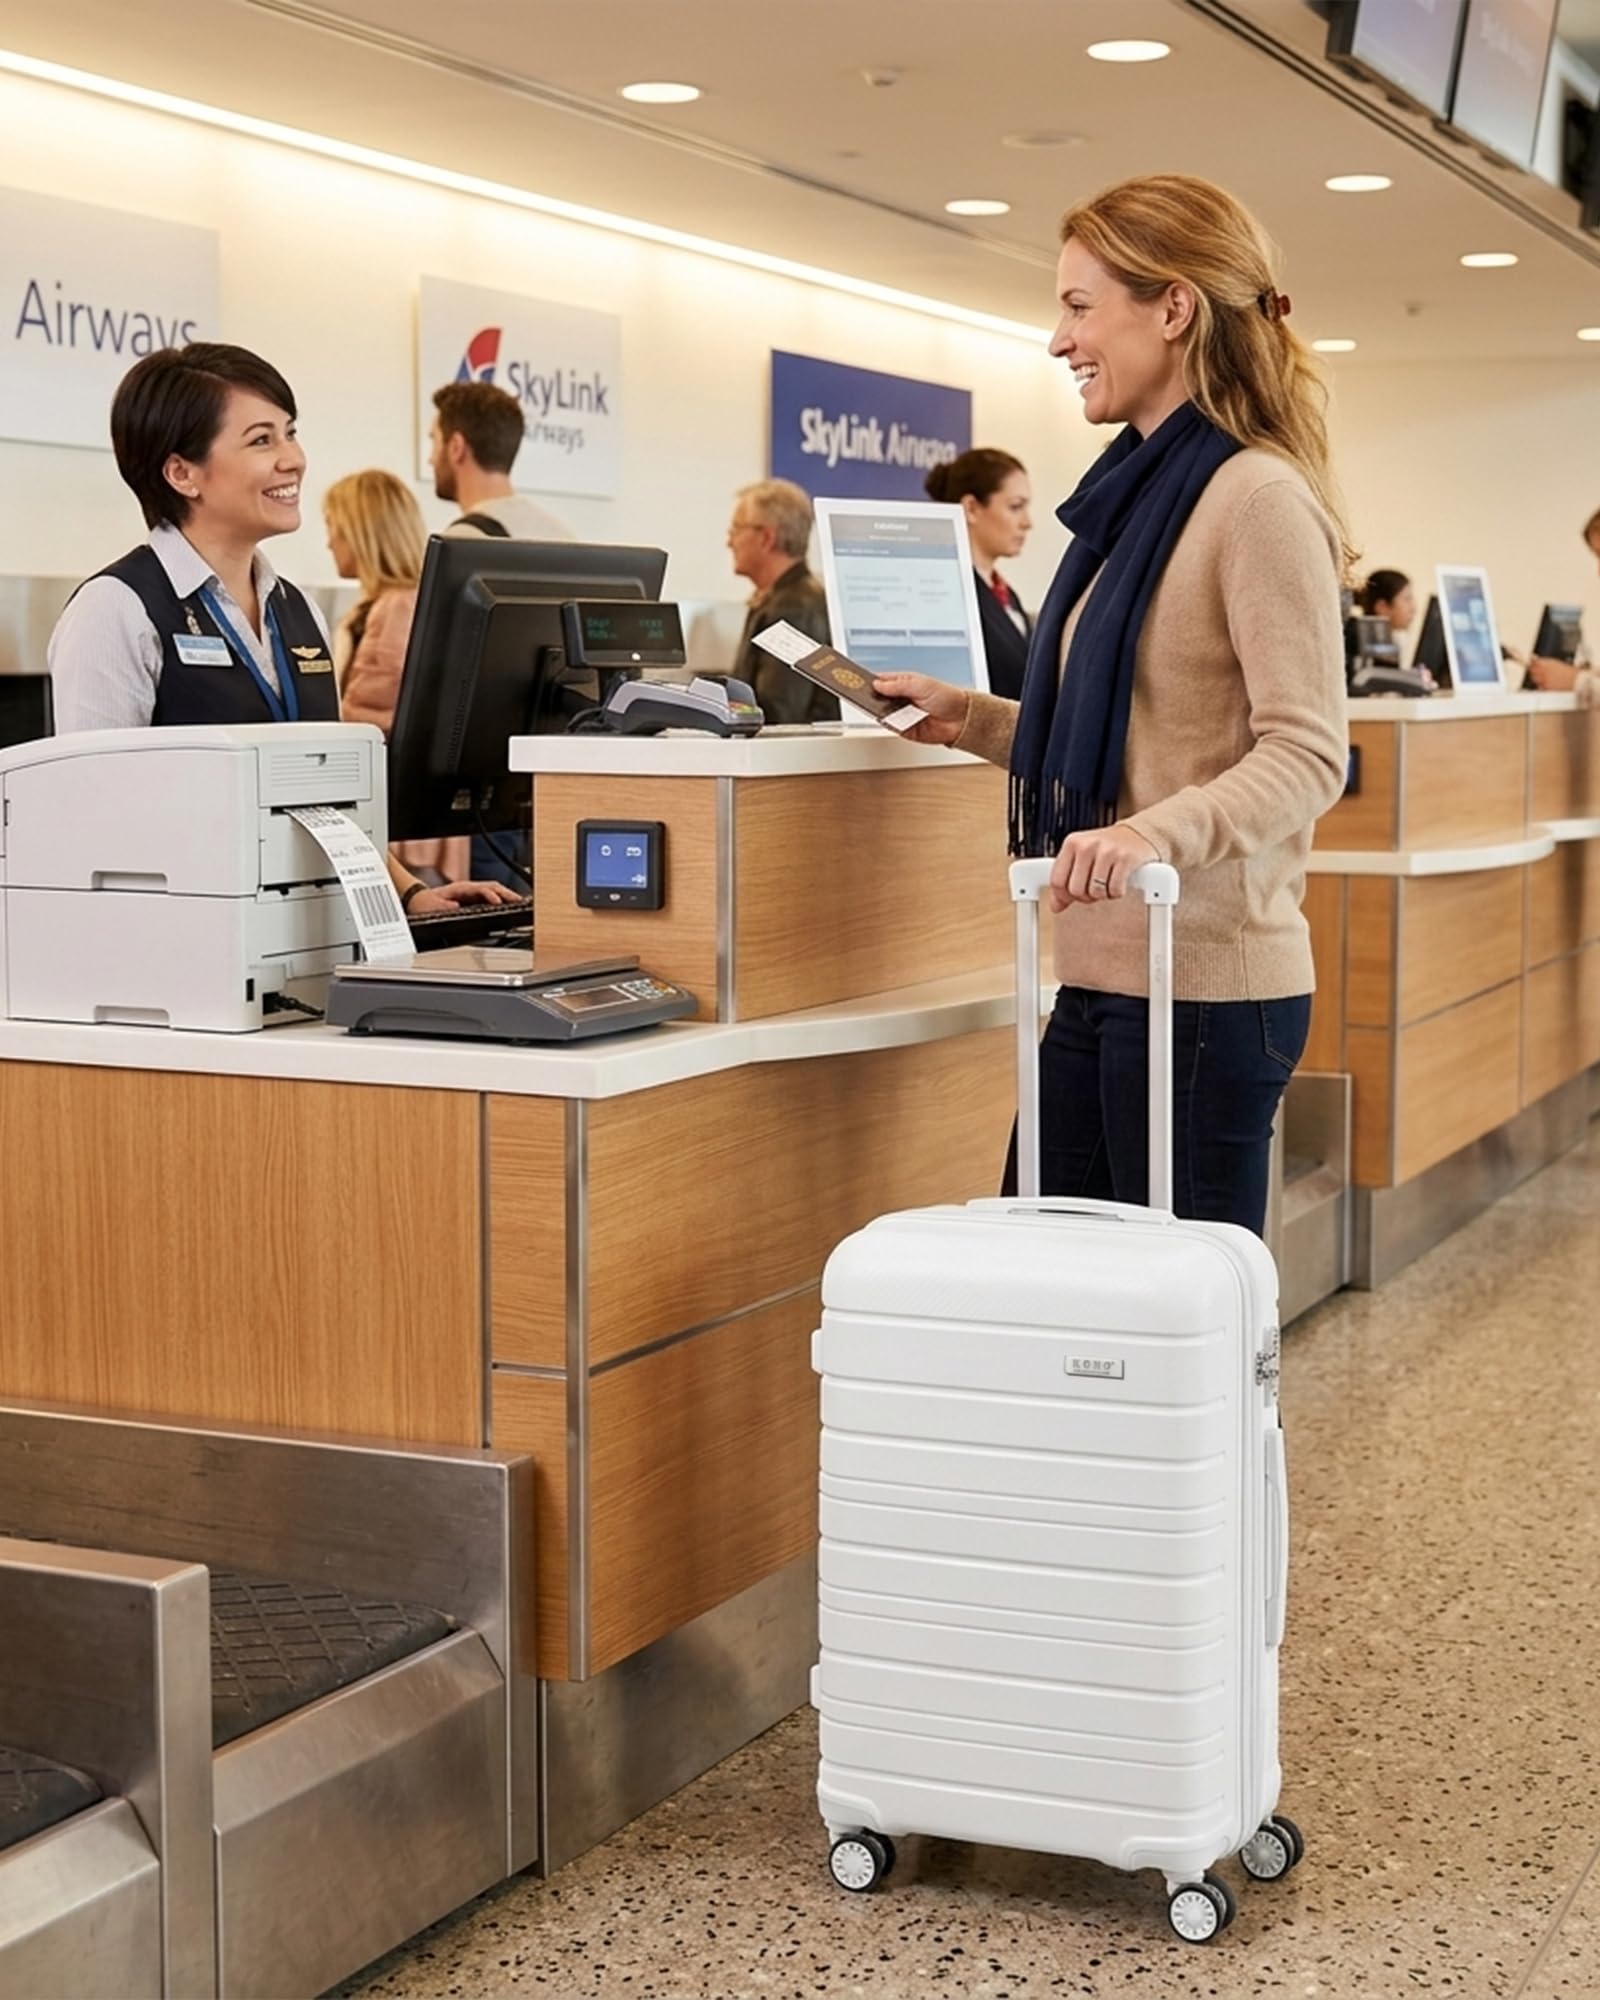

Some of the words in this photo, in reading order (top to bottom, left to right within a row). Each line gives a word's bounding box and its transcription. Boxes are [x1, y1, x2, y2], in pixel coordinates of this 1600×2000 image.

[15, 279, 198, 358] Airways
[507, 361, 608, 416] SkyLink
[524, 420, 584, 453] irways
[801, 407, 884, 468] SkyLink
